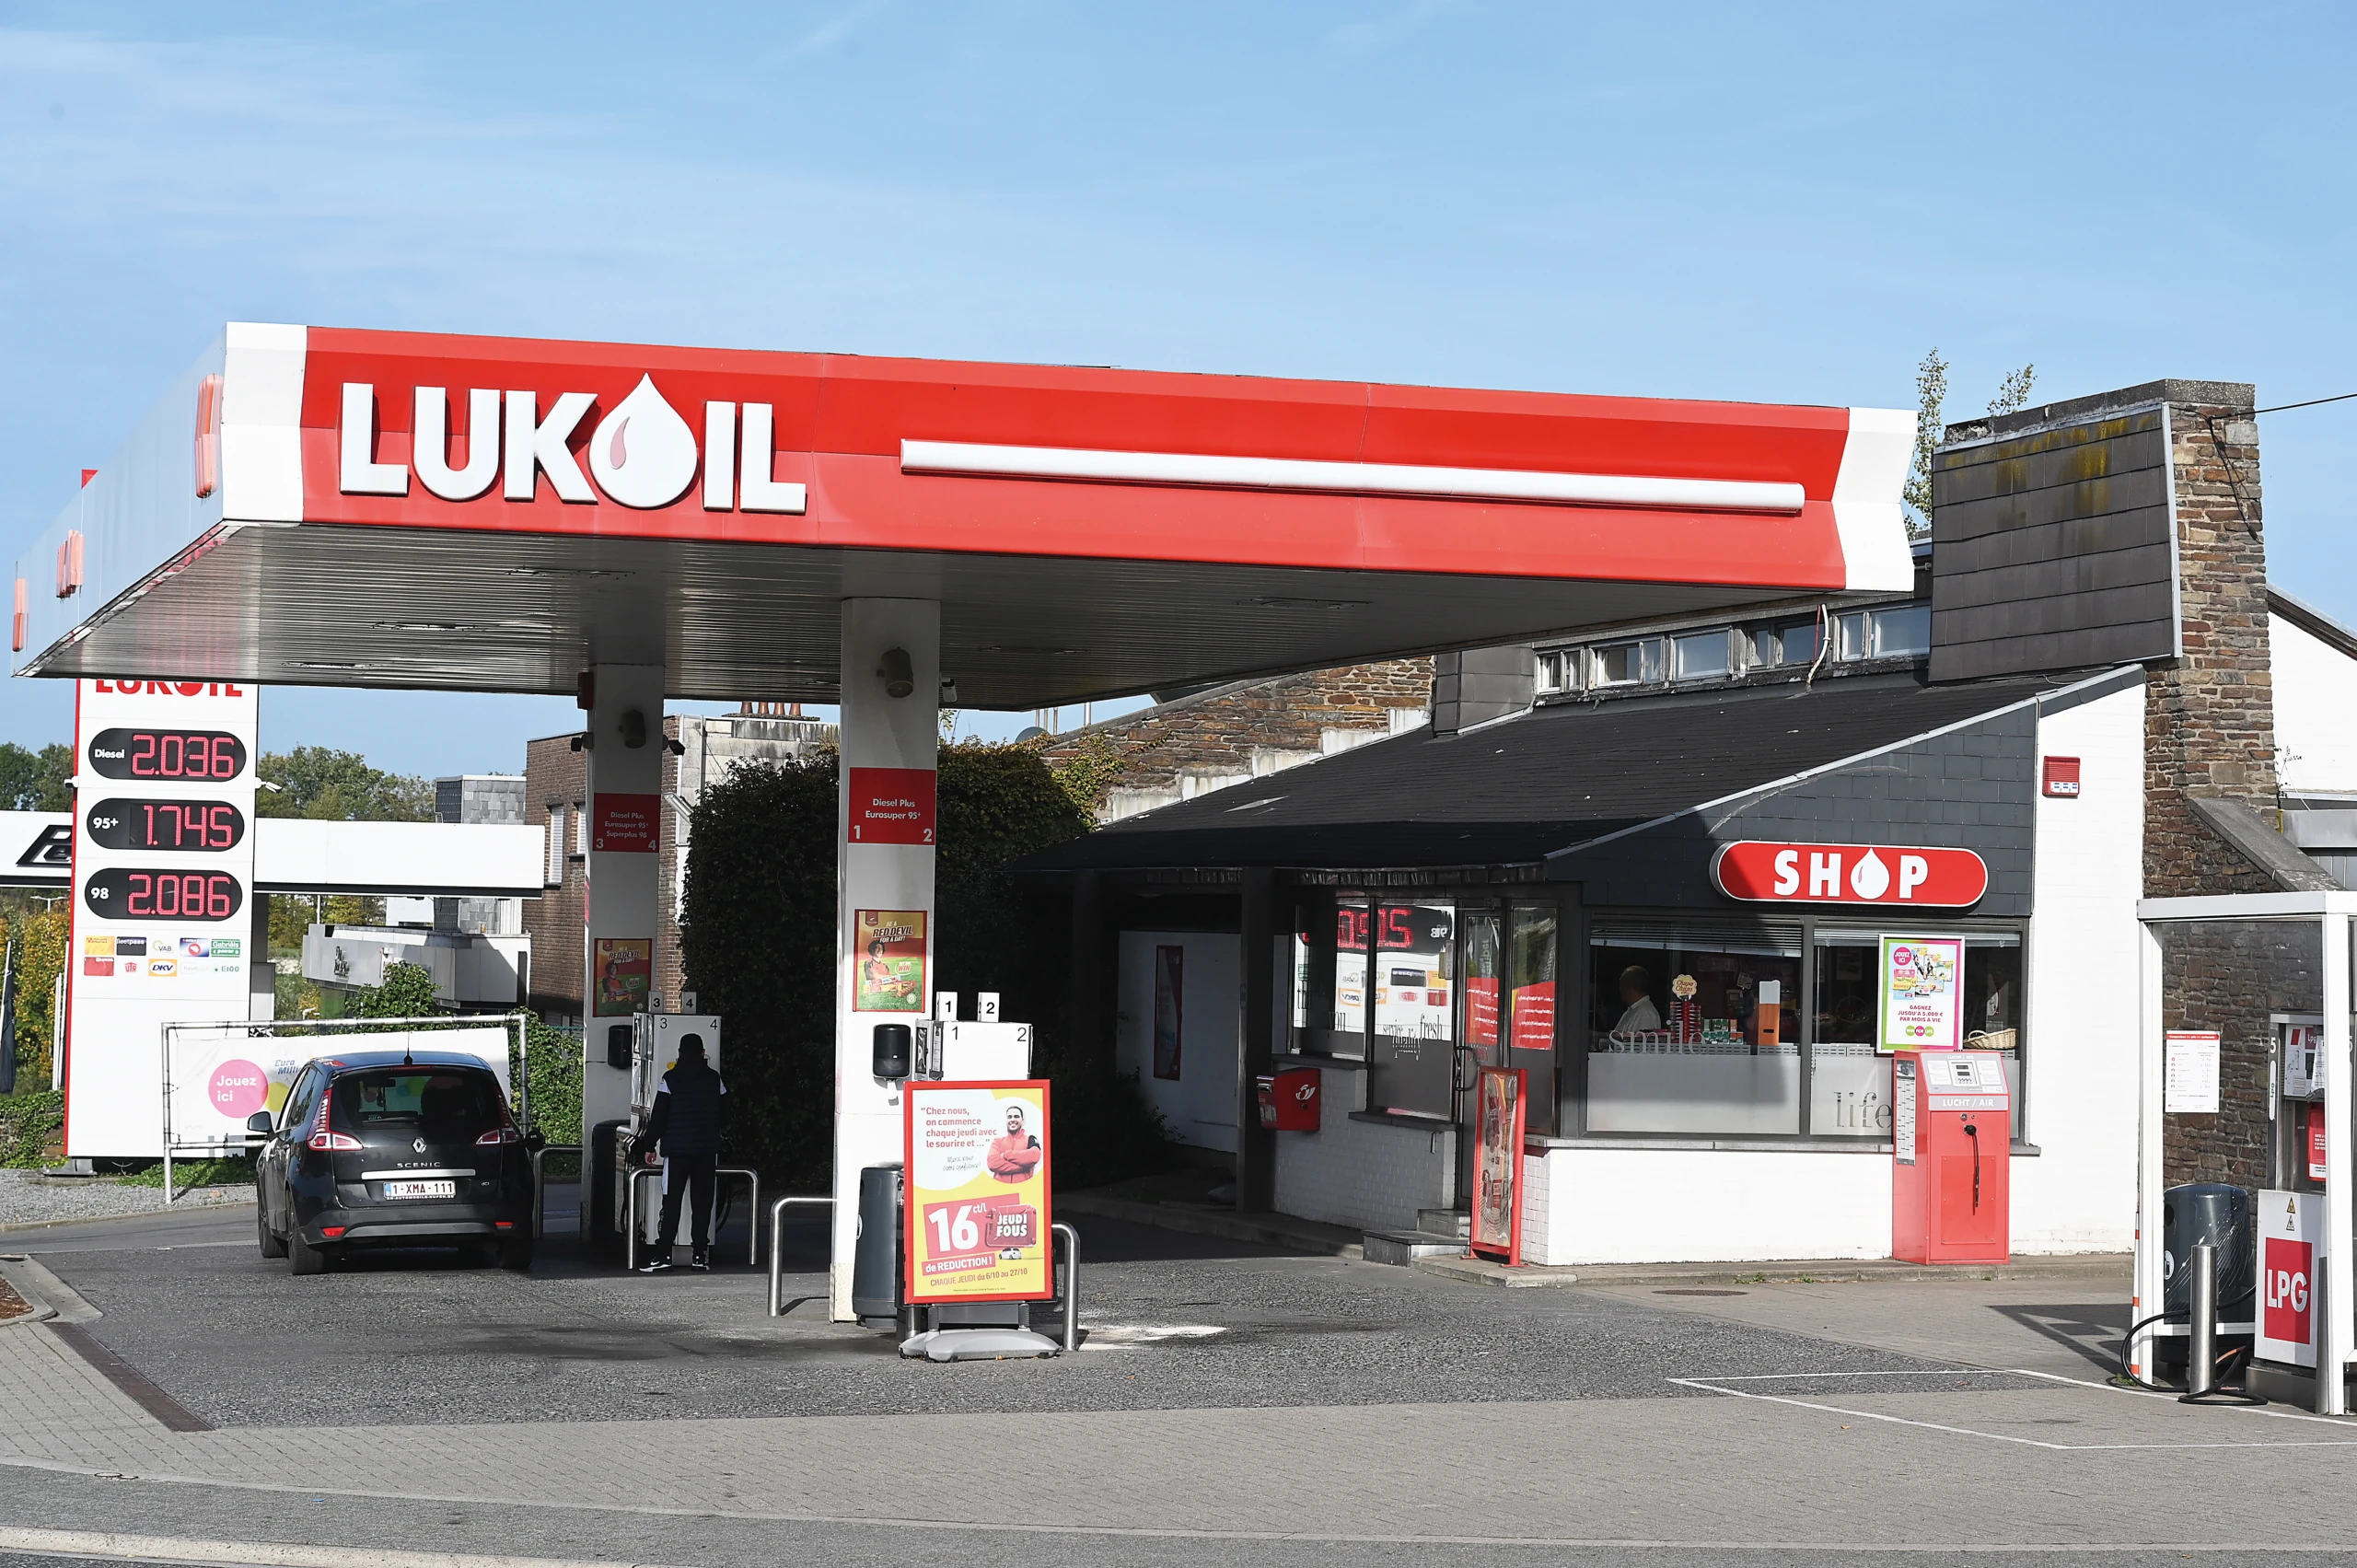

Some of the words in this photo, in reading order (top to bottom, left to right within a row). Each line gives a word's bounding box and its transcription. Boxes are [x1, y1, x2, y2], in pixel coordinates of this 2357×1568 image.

[339, 373, 807, 514] LUKOIL
[94, 749, 125, 760] Diesel
[132, 734, 235, 778] 2.036
[872, 798, 898, 807] Diesel
[900, 799, 915, 807] Plus
[865, 810, 907, 820] Eurosuper
[93, 817, 119, 830] 95+
[143, 805, 233, 847] 1.745
[606, 830, 638, 839] Superplus
[853, 825, 861, 839] 1
[923, 828, 933, 842] 2
[596, 838, 604, 849] 3
[647, 840, 657, 851] 4
[1773, 847, 1929, 900] SHOP
[91, 888, 110, 900] 98
[128, 874, 231, 916] 2.086
[872, 927, 890, 938] RED
[890, 925, 913, 936] DEVIL
[898, 964, 911, 972] WIN
[653, 997, 661, 1007] 3
[686, 999, 693, 1008] 4
[945, 1001, 951, 1013] 1
[985, 1002, 994, 1014] 2
[659, 1017, 668, 1028] 3
[710, 1018, 718, 1030] 4
[1420, 1014, 1443, 1040] fresh
[952, 1026, 958, 1040] 1
[1016, 1027, 1027, 1041] 2
[1608, 1019, 1706, 1054] smile
[2270, 1037, 2276, 1053] 5
[274, 1059, 296, 1067] Euro
[216, 1075, 257, 1086] Jouez
[216, 1091, 234, 1102] ici
[1943, 1098, 1969, 1107] LUCHT
[1971, 1098, 1978, 1108] /
[1979, 1098, 1994, 1107] AIR
[947, 1107, 970, 1116] nous,
[1832, 1091, 1892, 1129] life
[937, 1118, 981, 1126] commence
[925, 1129, 956, 1139] chaque
[957, 1128, 977, 1138] jeudi
[926, 1140, 934, 1148] le
[935, 1139, 966, 1148] sourire
[392, 1182, 453, 1195] 1-XMA-111
[997, 1213, 1028, 1225] JEUDI
[928, 1204, 979, 1252] 16
[972, 1202, 988, 1214] ct/l
[996, 1224, 1028, 1237] FOUS
[925, 1263, 936, 1272] de
[936, 1257, 988, 1272] REDUCTION
[930, 1276, 957, 1286] CHAQUE
[957, 1274, 976, 1283] JEUDI
[985, 1272, 1000, 1280] 6/10
[1009, 1267, 1028, 1277] 27/10
[2267, 1269, 2308, 1312] LPG
